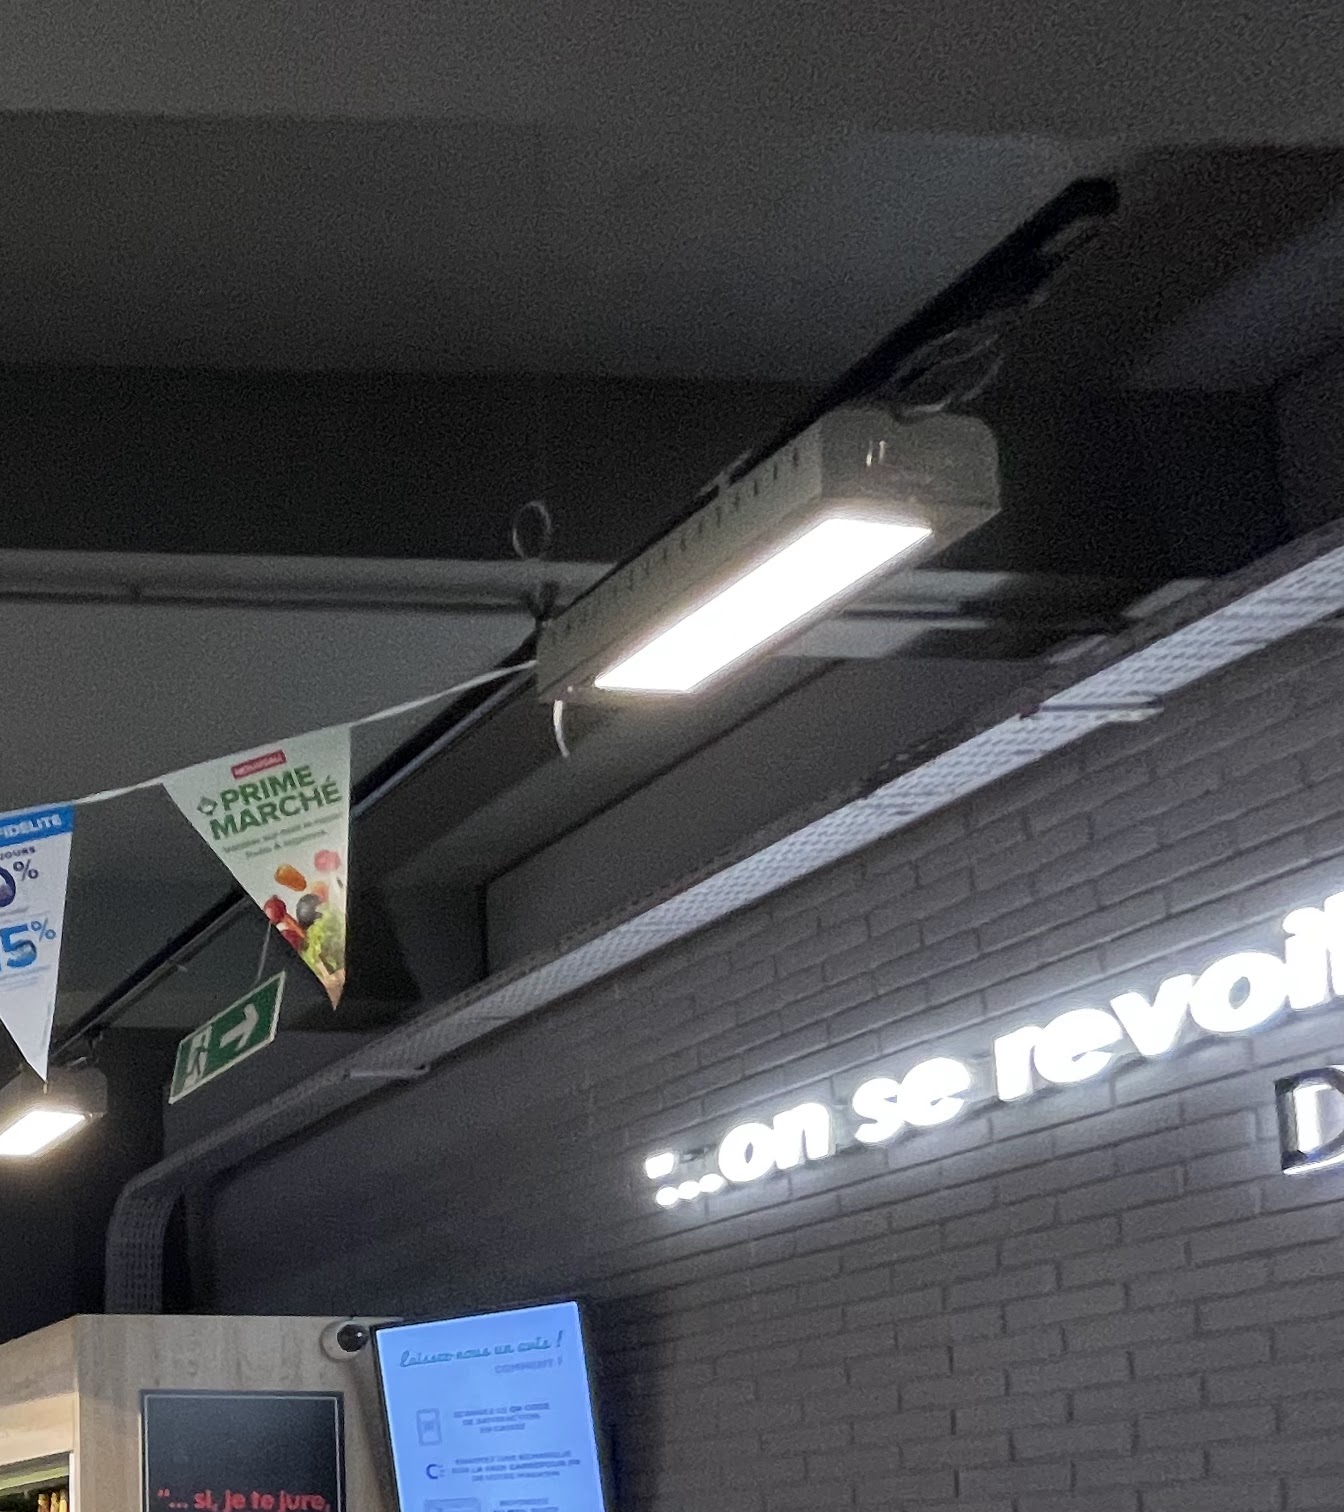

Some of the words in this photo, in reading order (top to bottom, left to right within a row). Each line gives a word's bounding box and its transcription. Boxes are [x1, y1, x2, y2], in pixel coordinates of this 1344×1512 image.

[209, 774, 342, 840] MARCHÉ
[220, 765, 315, 811] PRIME
[852, 1057, 975, 1146] se
